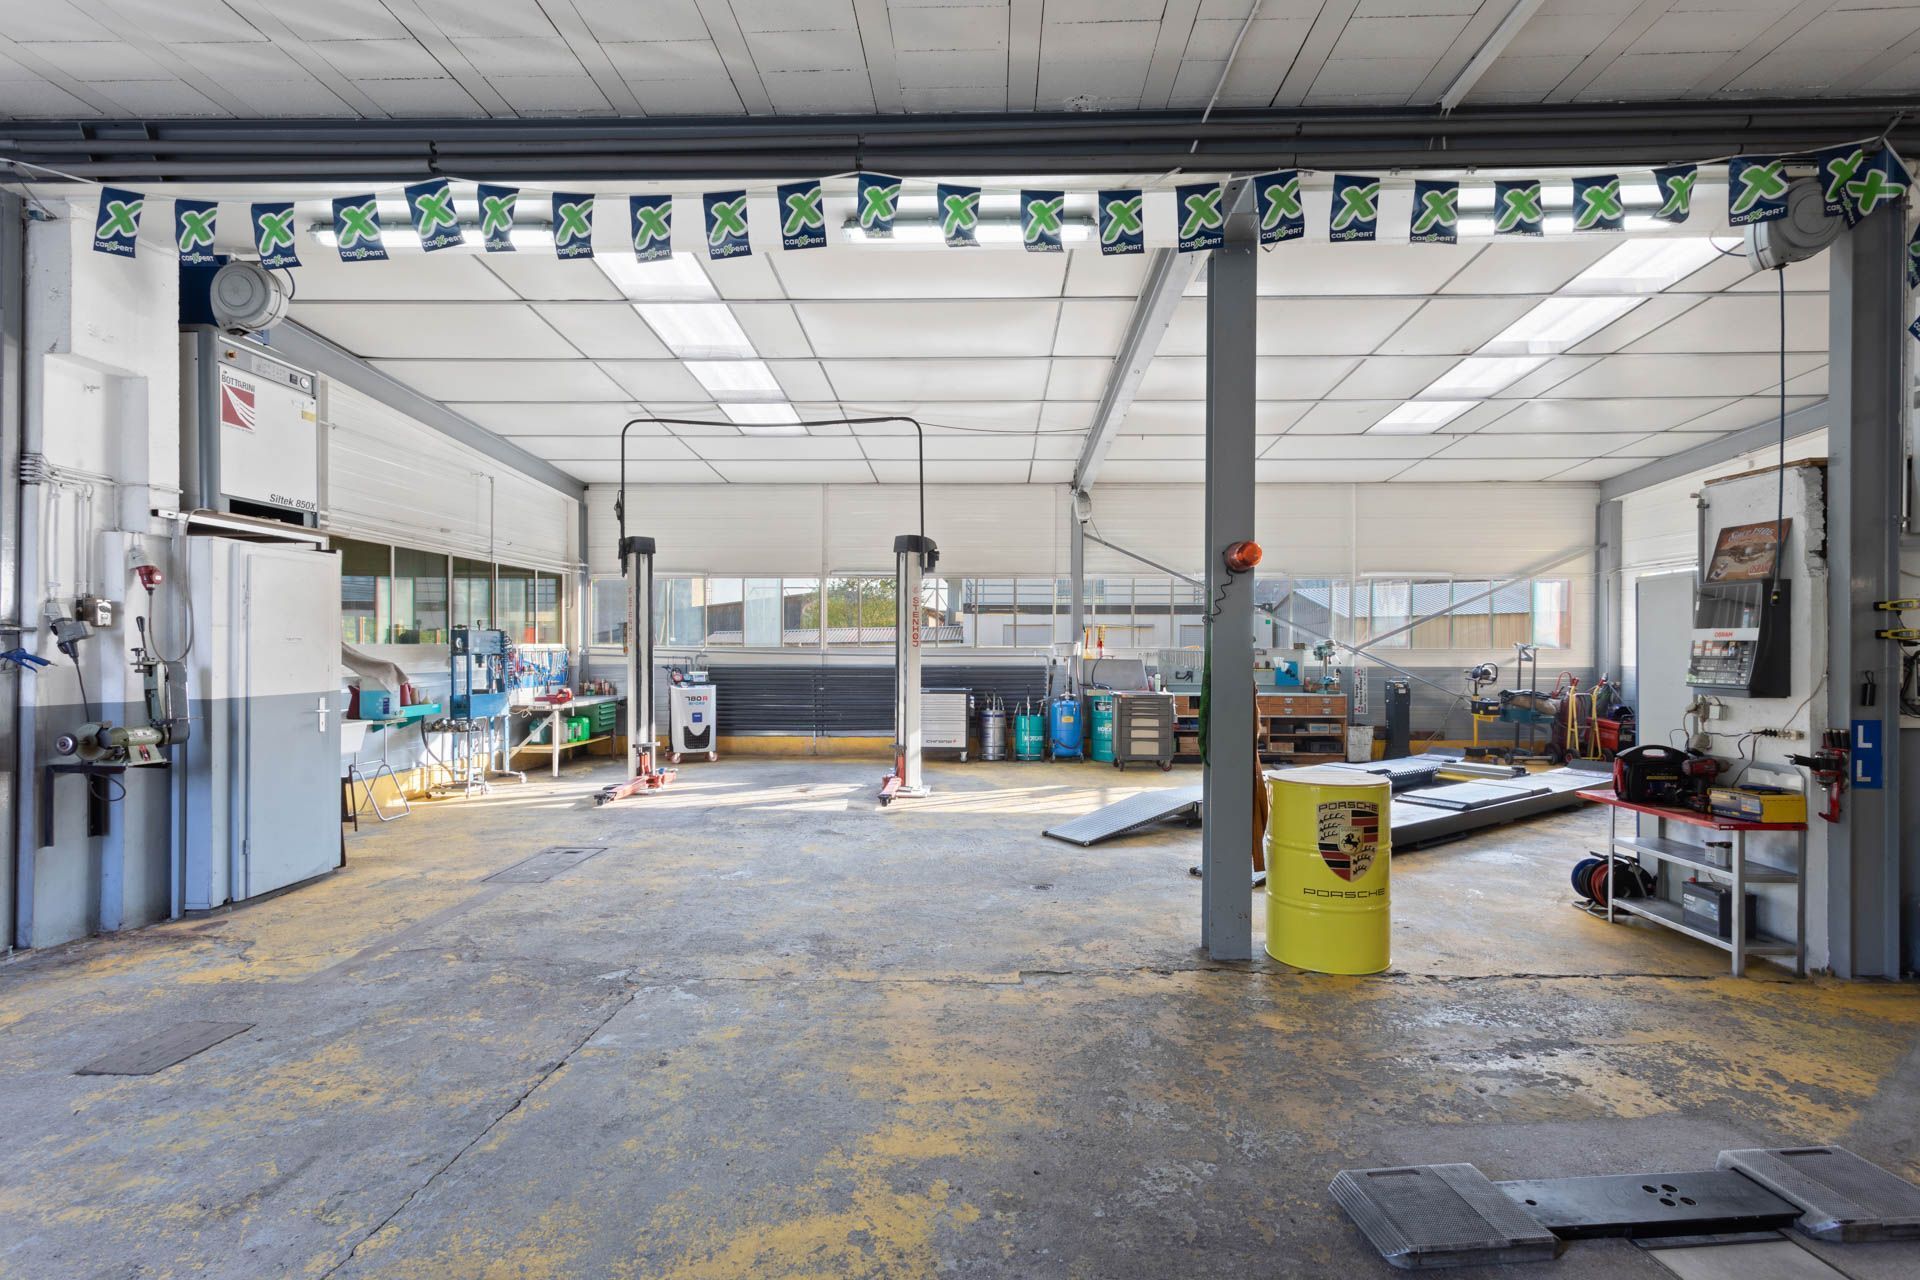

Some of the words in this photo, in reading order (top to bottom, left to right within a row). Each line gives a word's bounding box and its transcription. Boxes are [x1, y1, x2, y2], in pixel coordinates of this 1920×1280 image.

[222, 374, 255, 392] BOTTARINI
[270, 494, 293, 506] Siltek
[296, 500, 316, 510] 850X
[1858, 725, 1872, 748] L
[1857, 760, 1871, 782] L
[1319, 801, 1378, 812] PORSCHE
[1303, 888, 1385, 899] PORSCHE
